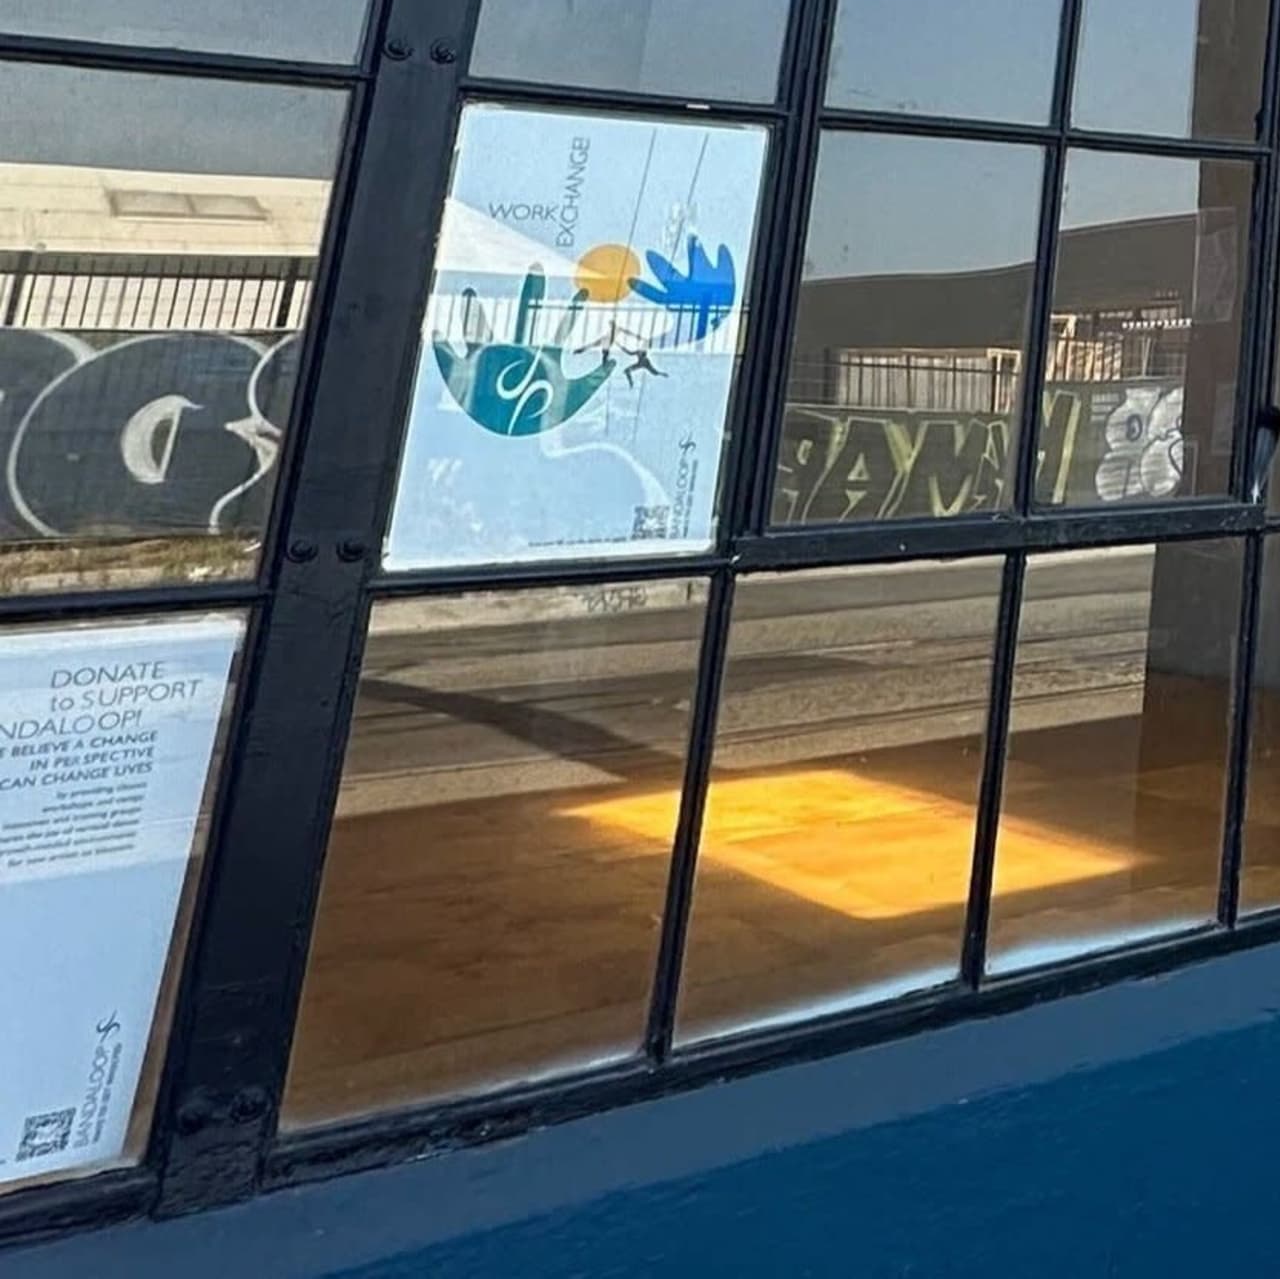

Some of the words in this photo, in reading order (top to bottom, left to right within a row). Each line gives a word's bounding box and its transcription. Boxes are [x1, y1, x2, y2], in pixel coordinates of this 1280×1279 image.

[556, 137, 591, 247] EXCHANGE
[489, 202, 559, 222] WORK
[51, 662, 165, 688] DONATE
[51, 695, 75, 712] to
[82, 680, 200, 707] SUPPORT
[11, 741, 70, 757] BELIEVE
[73, 738, 84, 751] A
[91, 731, 157, 749] CHANGE
[30, 757, 49, 771] IN
[53, 746, 155, 769] PERSPECTIVE
[0, 775, 36, 790] CAN
[41, 768, 110, 785] CHANGE
[114, 762, 153, 777] LIVES
